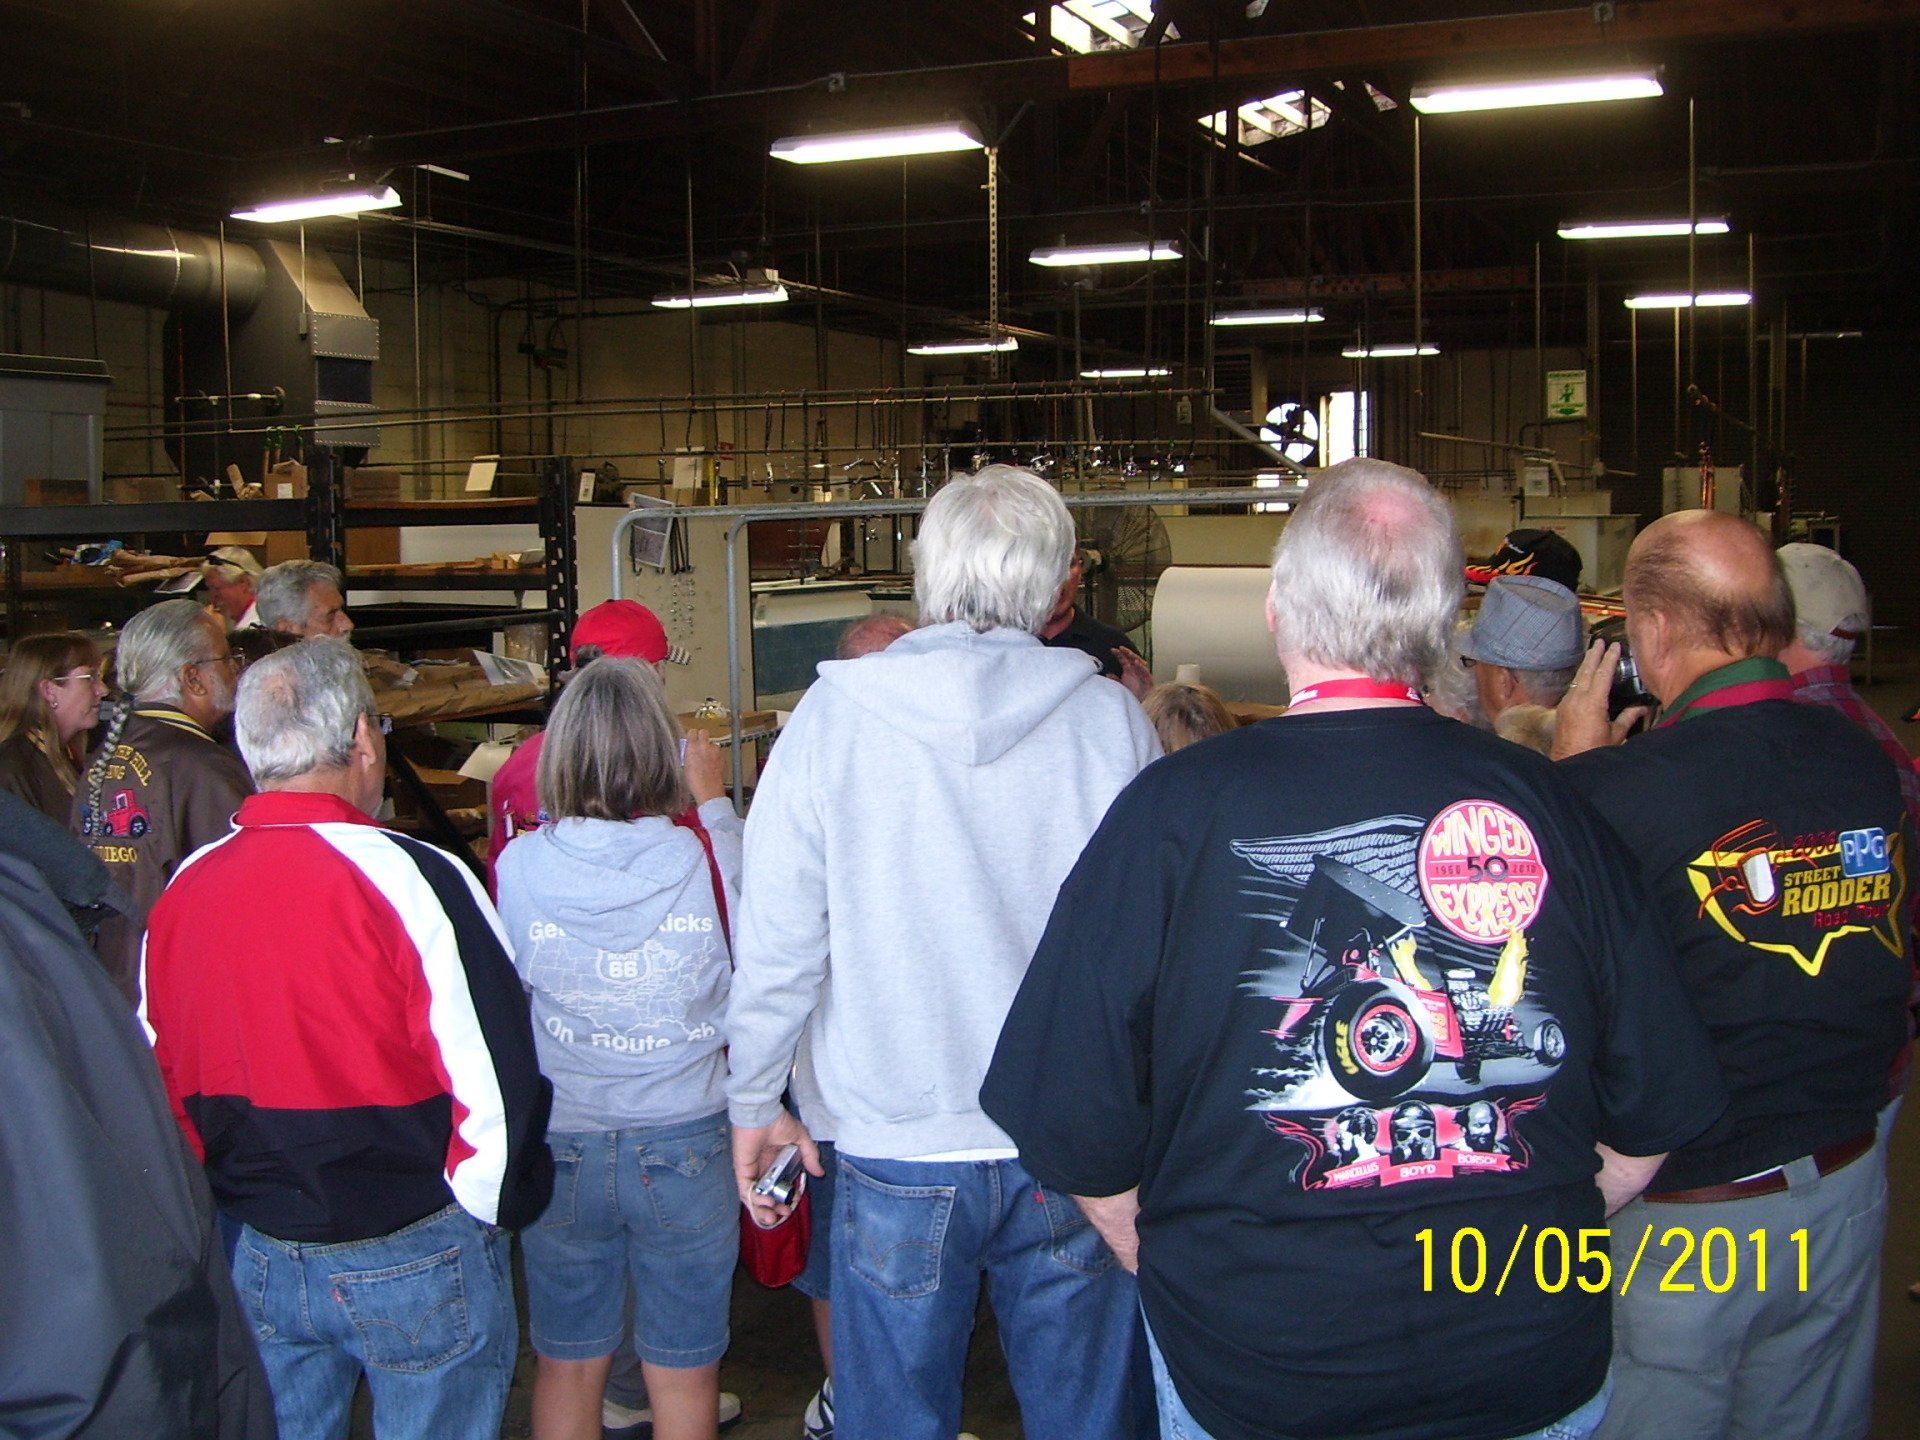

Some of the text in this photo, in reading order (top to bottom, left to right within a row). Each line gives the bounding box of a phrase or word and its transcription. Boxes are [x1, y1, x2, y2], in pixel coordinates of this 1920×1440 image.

[1430, 805, 1532, 857] WINGED
[1842, 831, 1885, 867] PPG
[1467, 855, 1509, 882] 50
[1784, 865, 1842, 888] STREET
[1430, 881, 1537, 936] EXPRESS
[1782, 872, 1892, 917] RODDER
[659, 912, 713, 933] icks
[609, 960, 639, 978] 66
[546, 1017, 575, 1044] On
[591, 1033, 671, 1055] Route
[1400, 1164, 1436, 1178] BOYD
